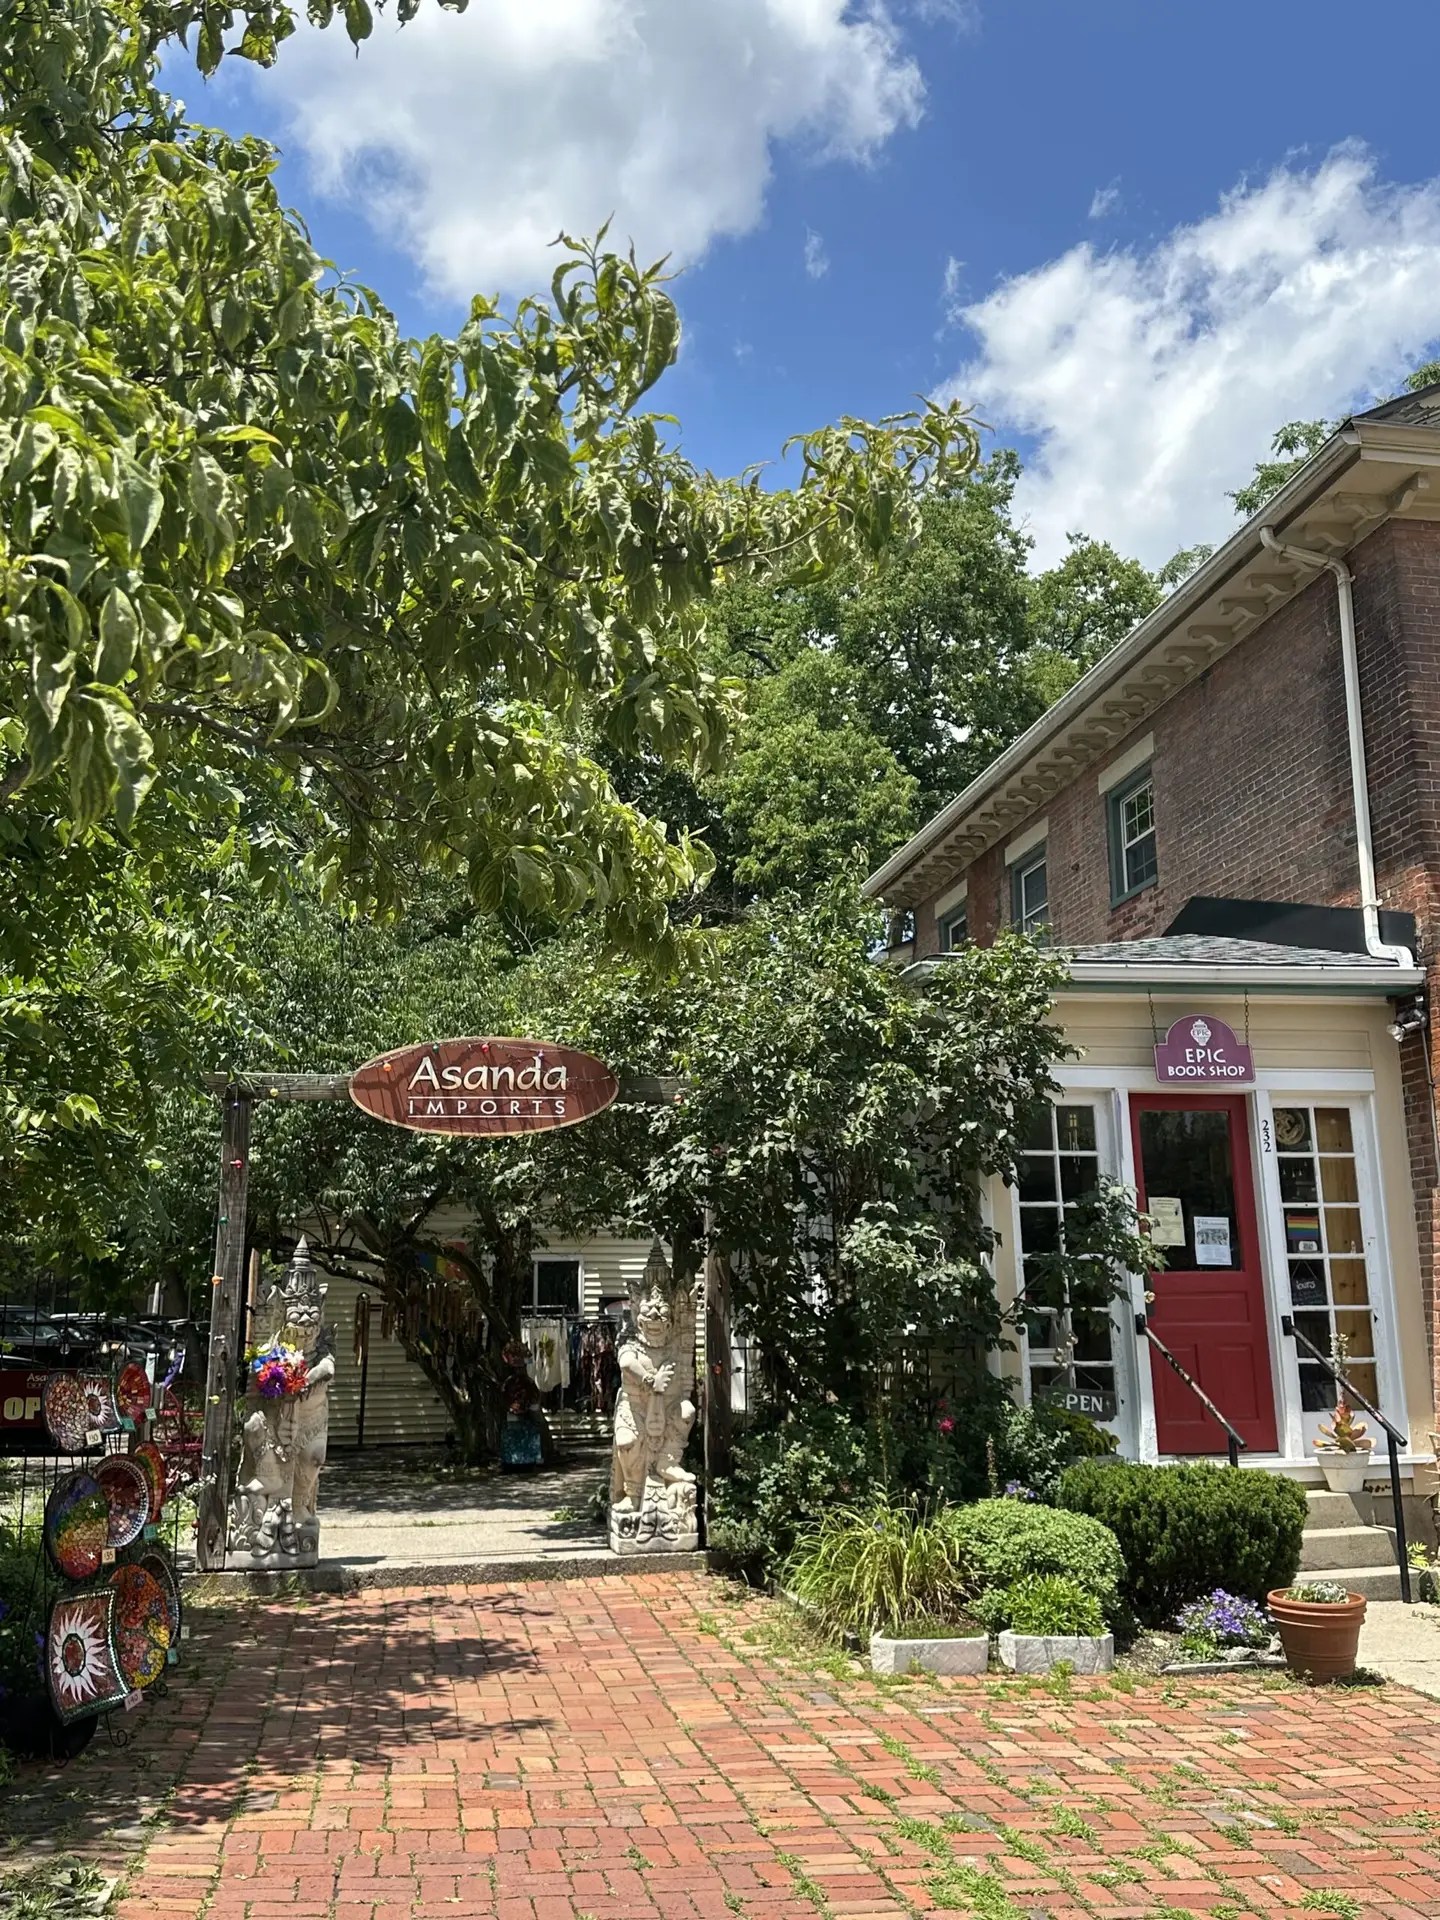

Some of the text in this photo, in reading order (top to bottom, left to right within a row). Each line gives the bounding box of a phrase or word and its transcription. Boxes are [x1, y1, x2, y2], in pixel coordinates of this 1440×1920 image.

[1185, 1048, 1226, 1063] EPIC
[407, 1055, 567, 1092] Asanda
[1167, 1065, 1246, 1077] BOOK SHOP
[409, 1100, 566, 1115] IMPORTS
[1261, 1119, 1272, 1153] 232
[26, 1372, 49, 1382] Asa
[3, 1396, 41, 1421] OP
